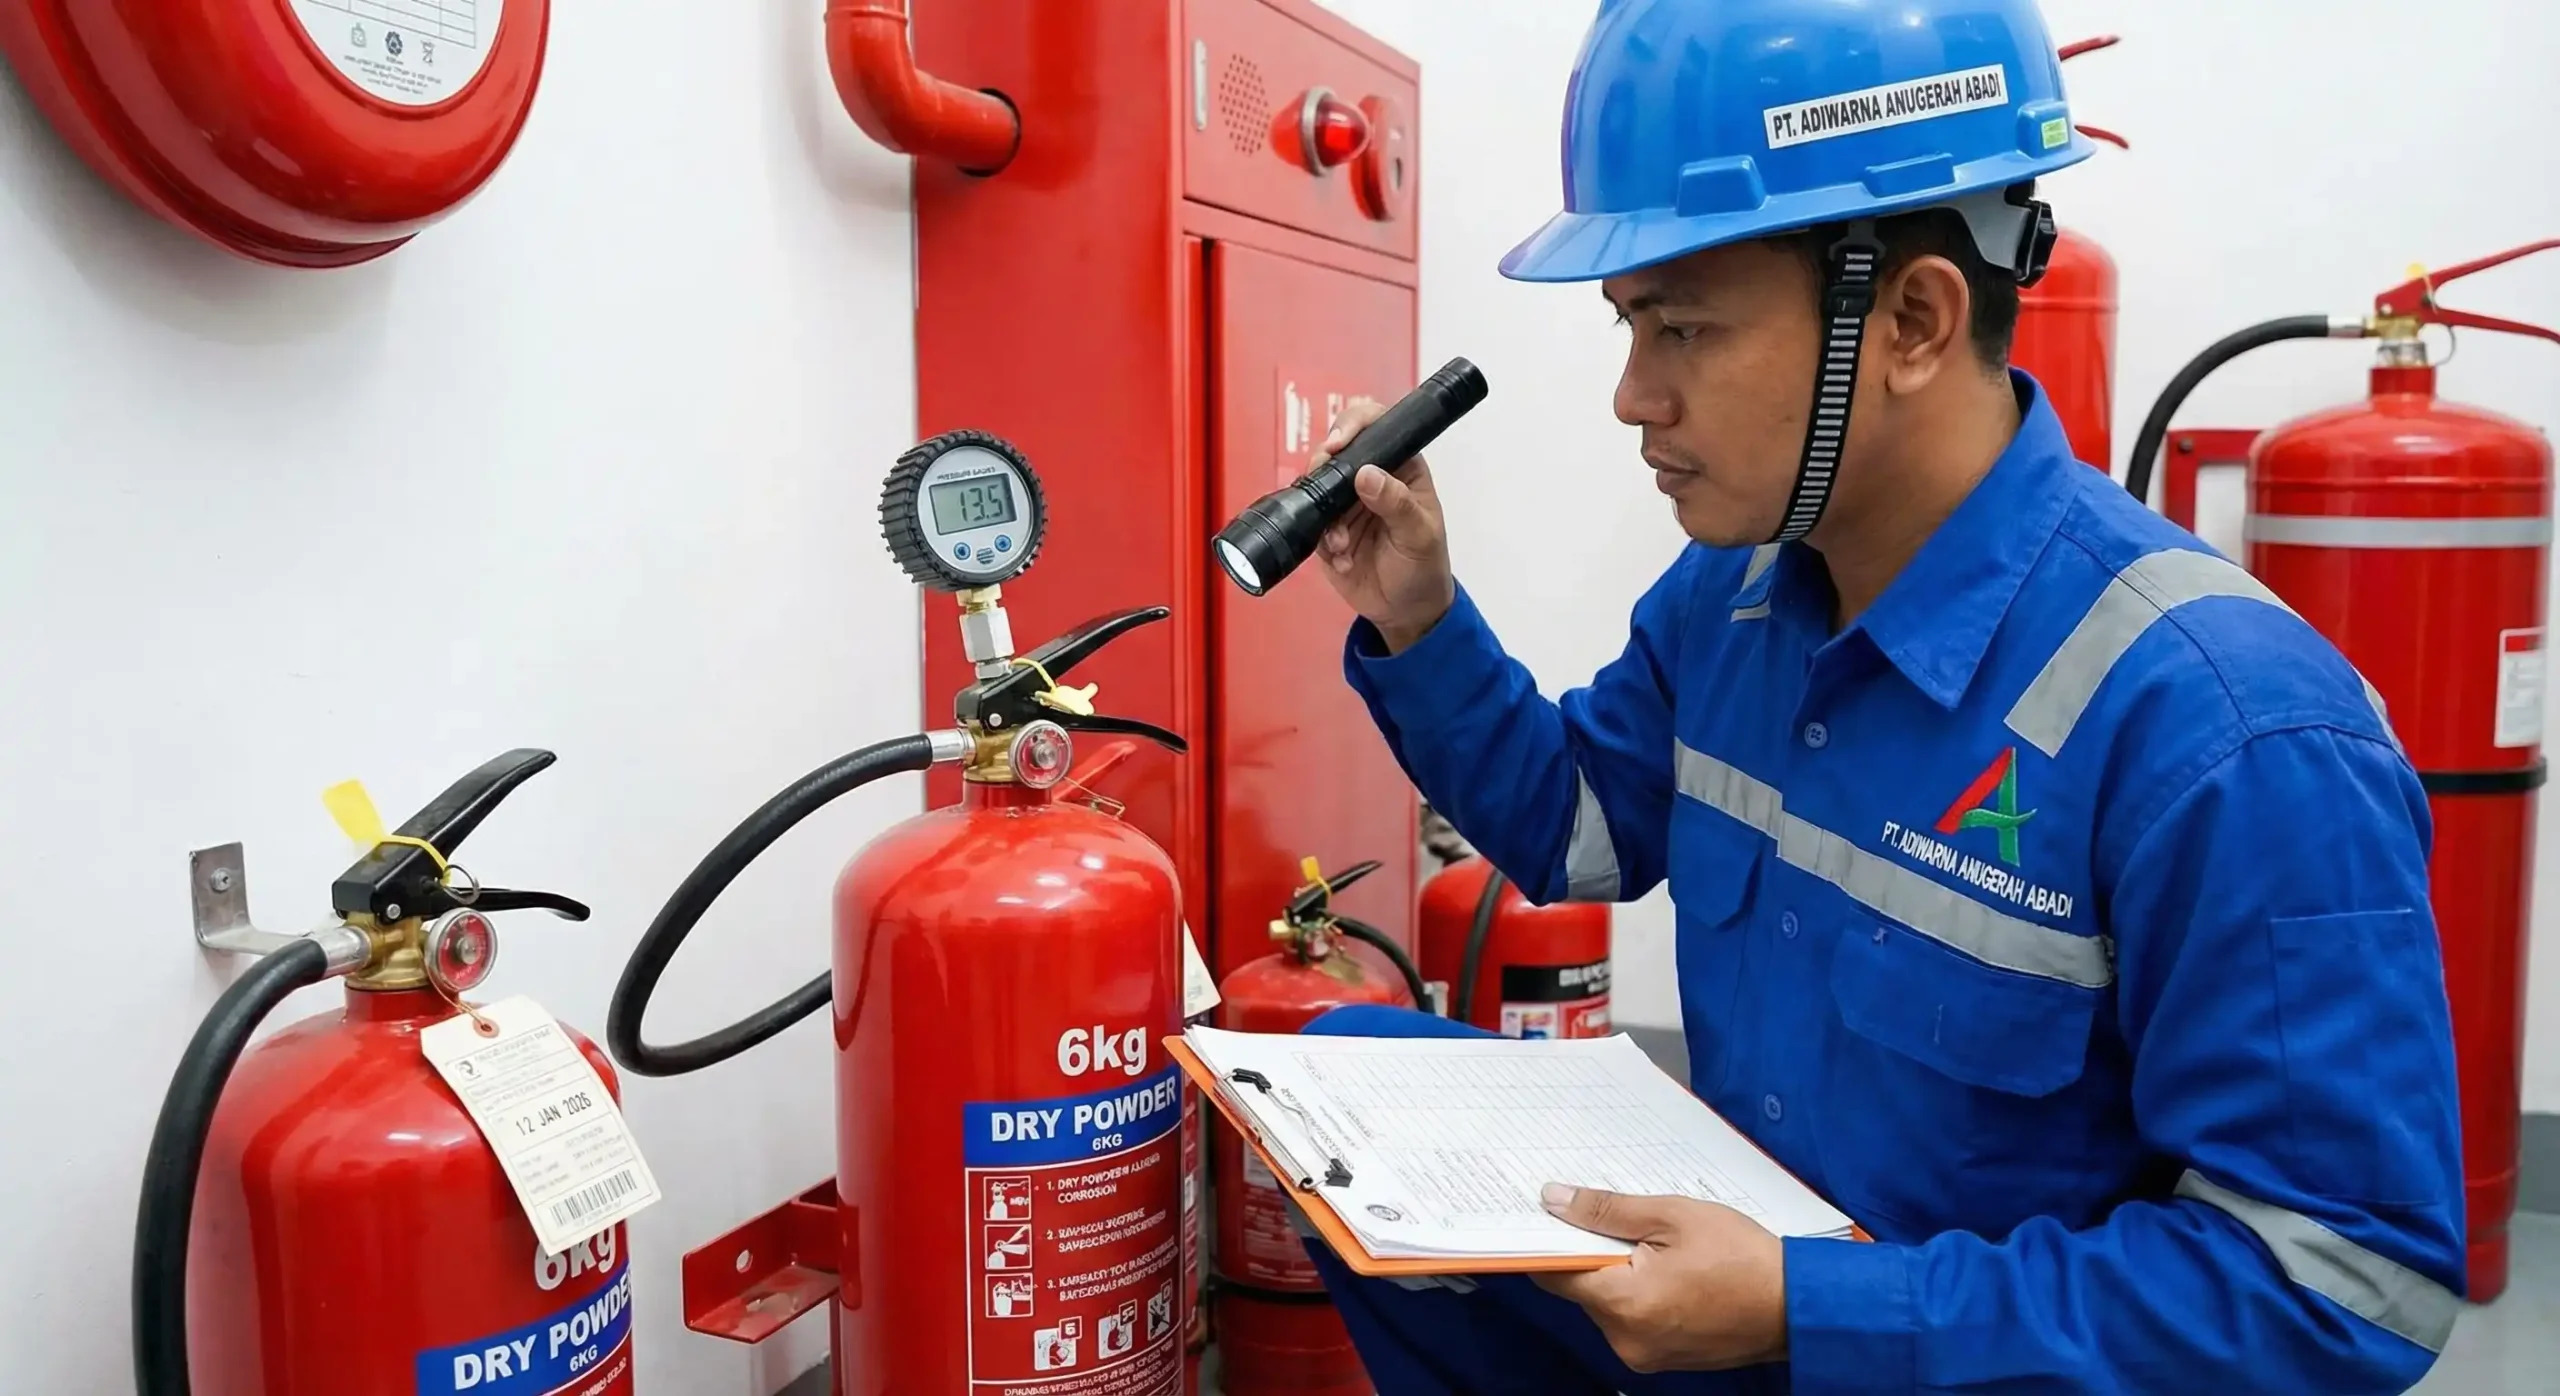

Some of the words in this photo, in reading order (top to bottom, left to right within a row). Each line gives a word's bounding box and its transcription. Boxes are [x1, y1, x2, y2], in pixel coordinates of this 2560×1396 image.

[1774, 113, 1797, 139] PT.
[1801, 94, 1882, 135] ADIWARNA
[1886, 78, 1963, 117] ANUGERAH
[1965, 72, 2002, 103] ABADI
[960, 484, 1003, 522] 13.5
[1881, 820, 1899, 848] PT.
[1898, 828, 1958, 873] ADIWARNA
[1957, 854, 2025, 904] ANUGERAH
[2025, 884, 2073, 919] ABADI
[1057, 1025, 1147, 1077] 6kg
[515, 1116, 535, 1136] 12
[539, 1104, 562, 1127] JAN
[563, 1092, 592, 1115] 2026
[992, 1109, 1063, 1142] DRY
[1074, 1076, 1177, 1135] POWDER
[1093, 1134, 1123, 1151] 6KG
[1057, 1177, 1079, 1190] DRY
[454, 1335, 537, 1391] DRY
[569, 1344, 598, 1372] 6KG
